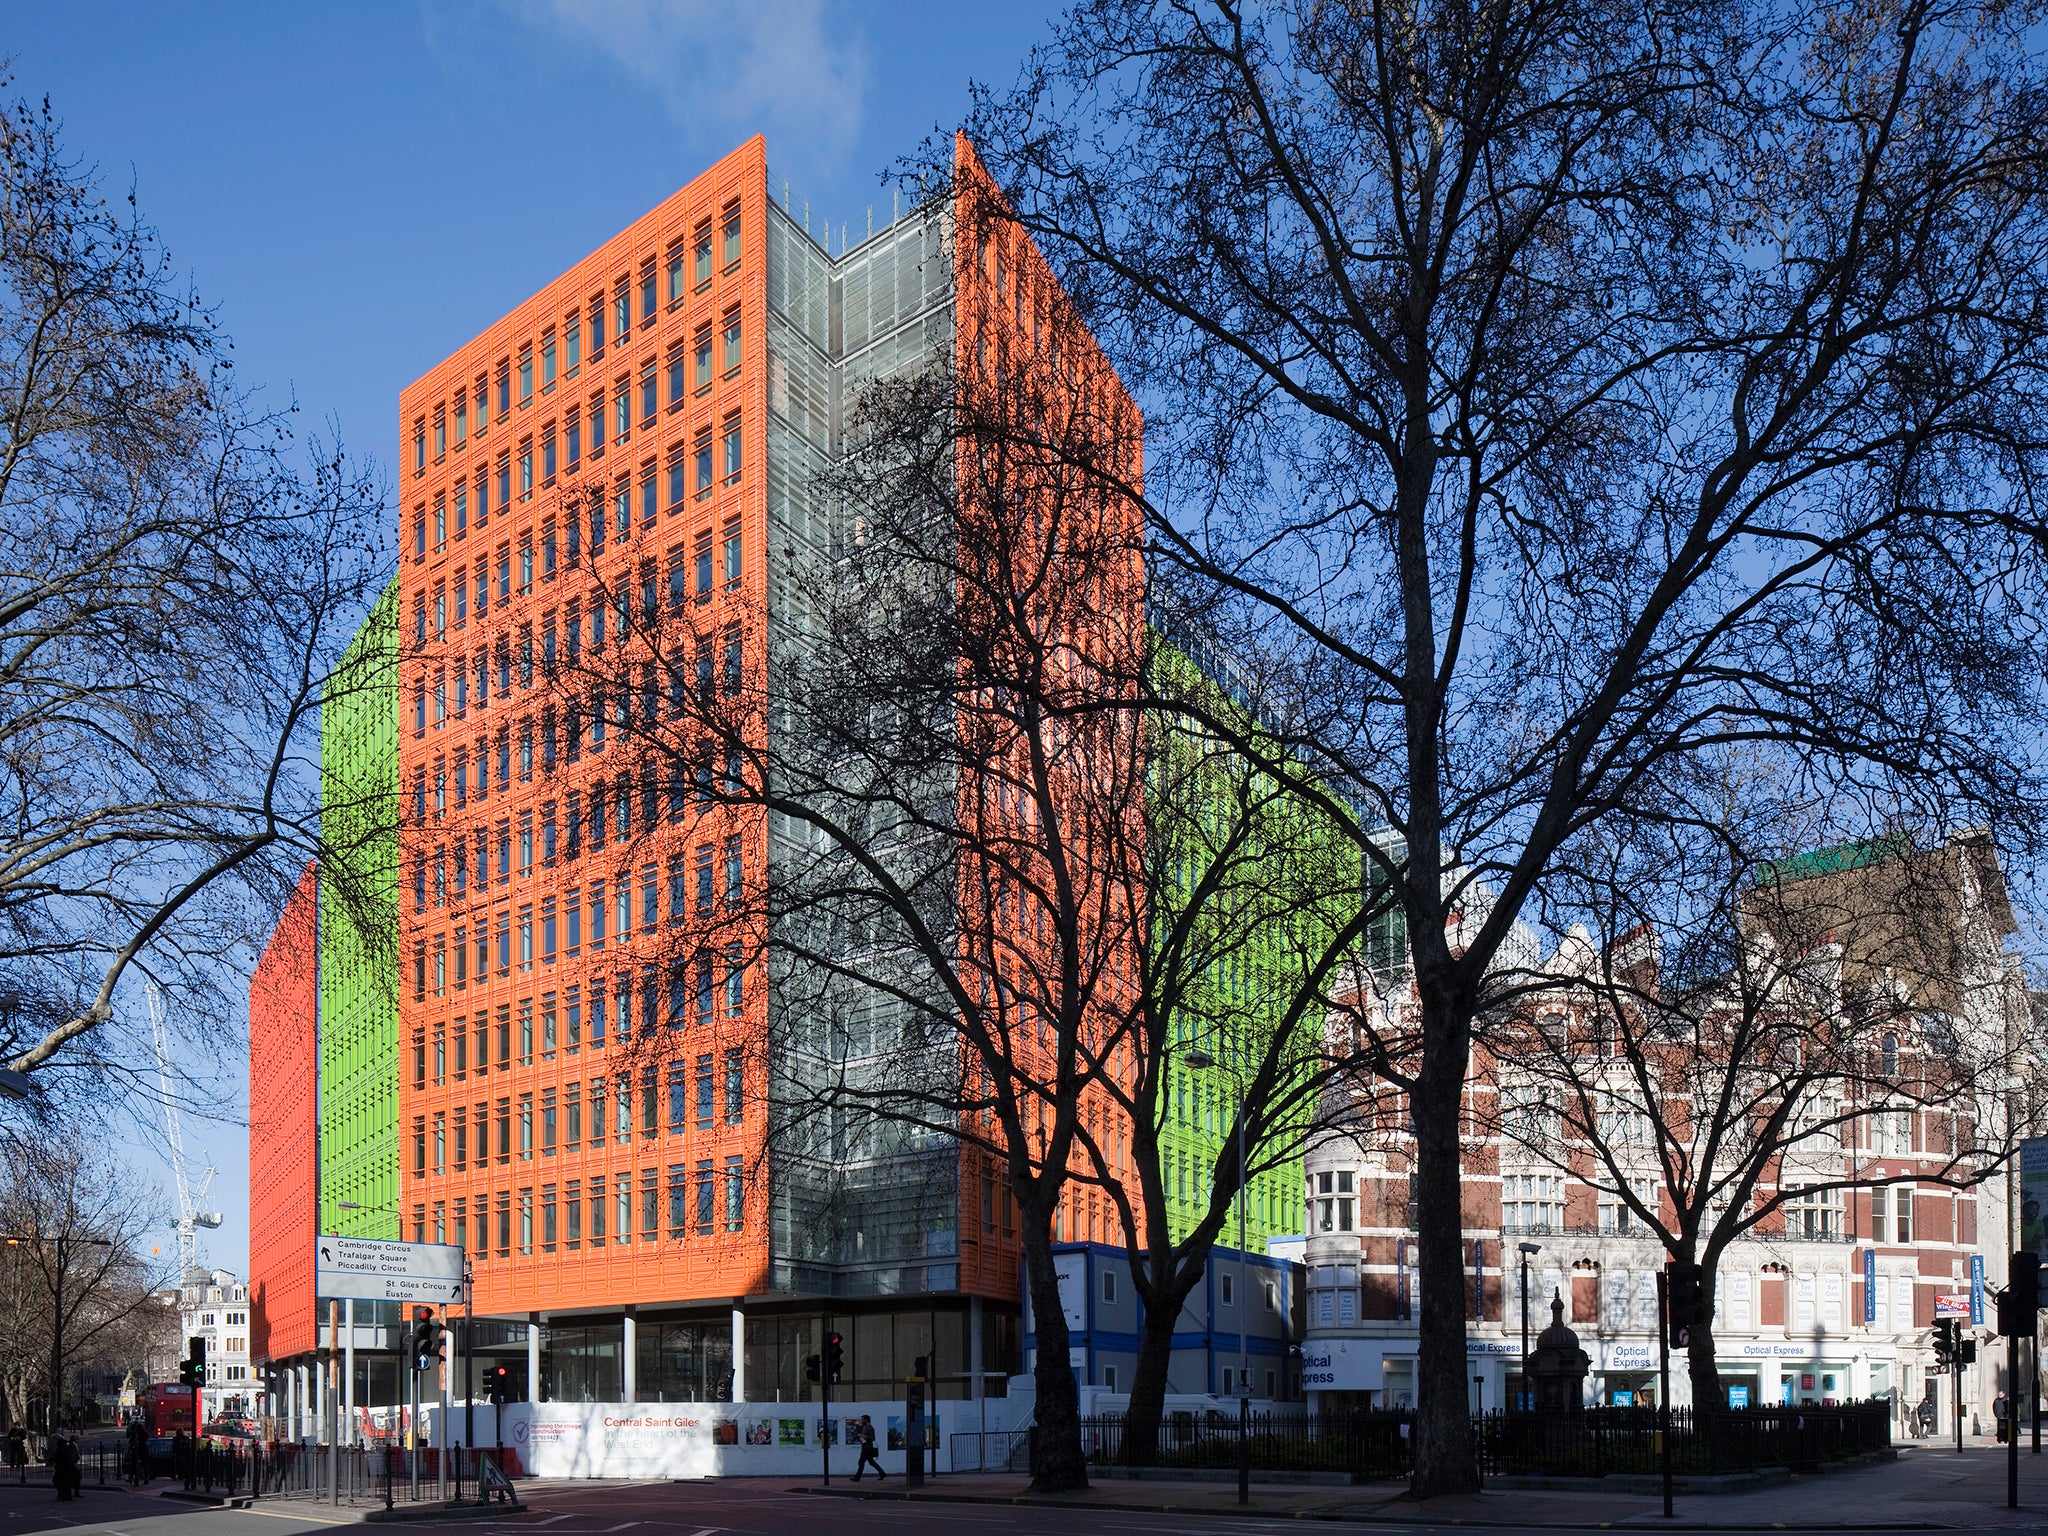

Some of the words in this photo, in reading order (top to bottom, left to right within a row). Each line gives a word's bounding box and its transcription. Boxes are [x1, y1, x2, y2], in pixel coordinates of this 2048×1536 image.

[337, 1240, 382, 1251] Cambridge
[385, 1244, 411, 1252] Circus
[338, 1251, 375, 1260] Trafalgar
[379, 1253, 407, 1263] Square
[338, 1262, 377, 1271] Piccadilly
[381, 1264, 407, 1273] Circus
[1465, 1343, 1486, 1352] tical
[1487, 1343, 1520, 1354] Express
[1616, 1346, 1649, 1357] Optical
[1743, 1346, 1771, 1355] Optical
[1773, 1346, 1804, 1355] Express
[1303, 1354, 1331, 1370] ptical
[1613, 1357, 1651, 1368] Express
[603, 1417, 642, 1427] Central
[645, 1417, 671, 1427] Saint
[674, 1417, 700, 1427] Giles
[636, 1429, 664, 1438] heart
[666, 1429, 677, 1438] of
[680, 1428, 696, 1438] the
[604, 1439, 628, 1449] West
[632, 1439, 653, 1449] End
